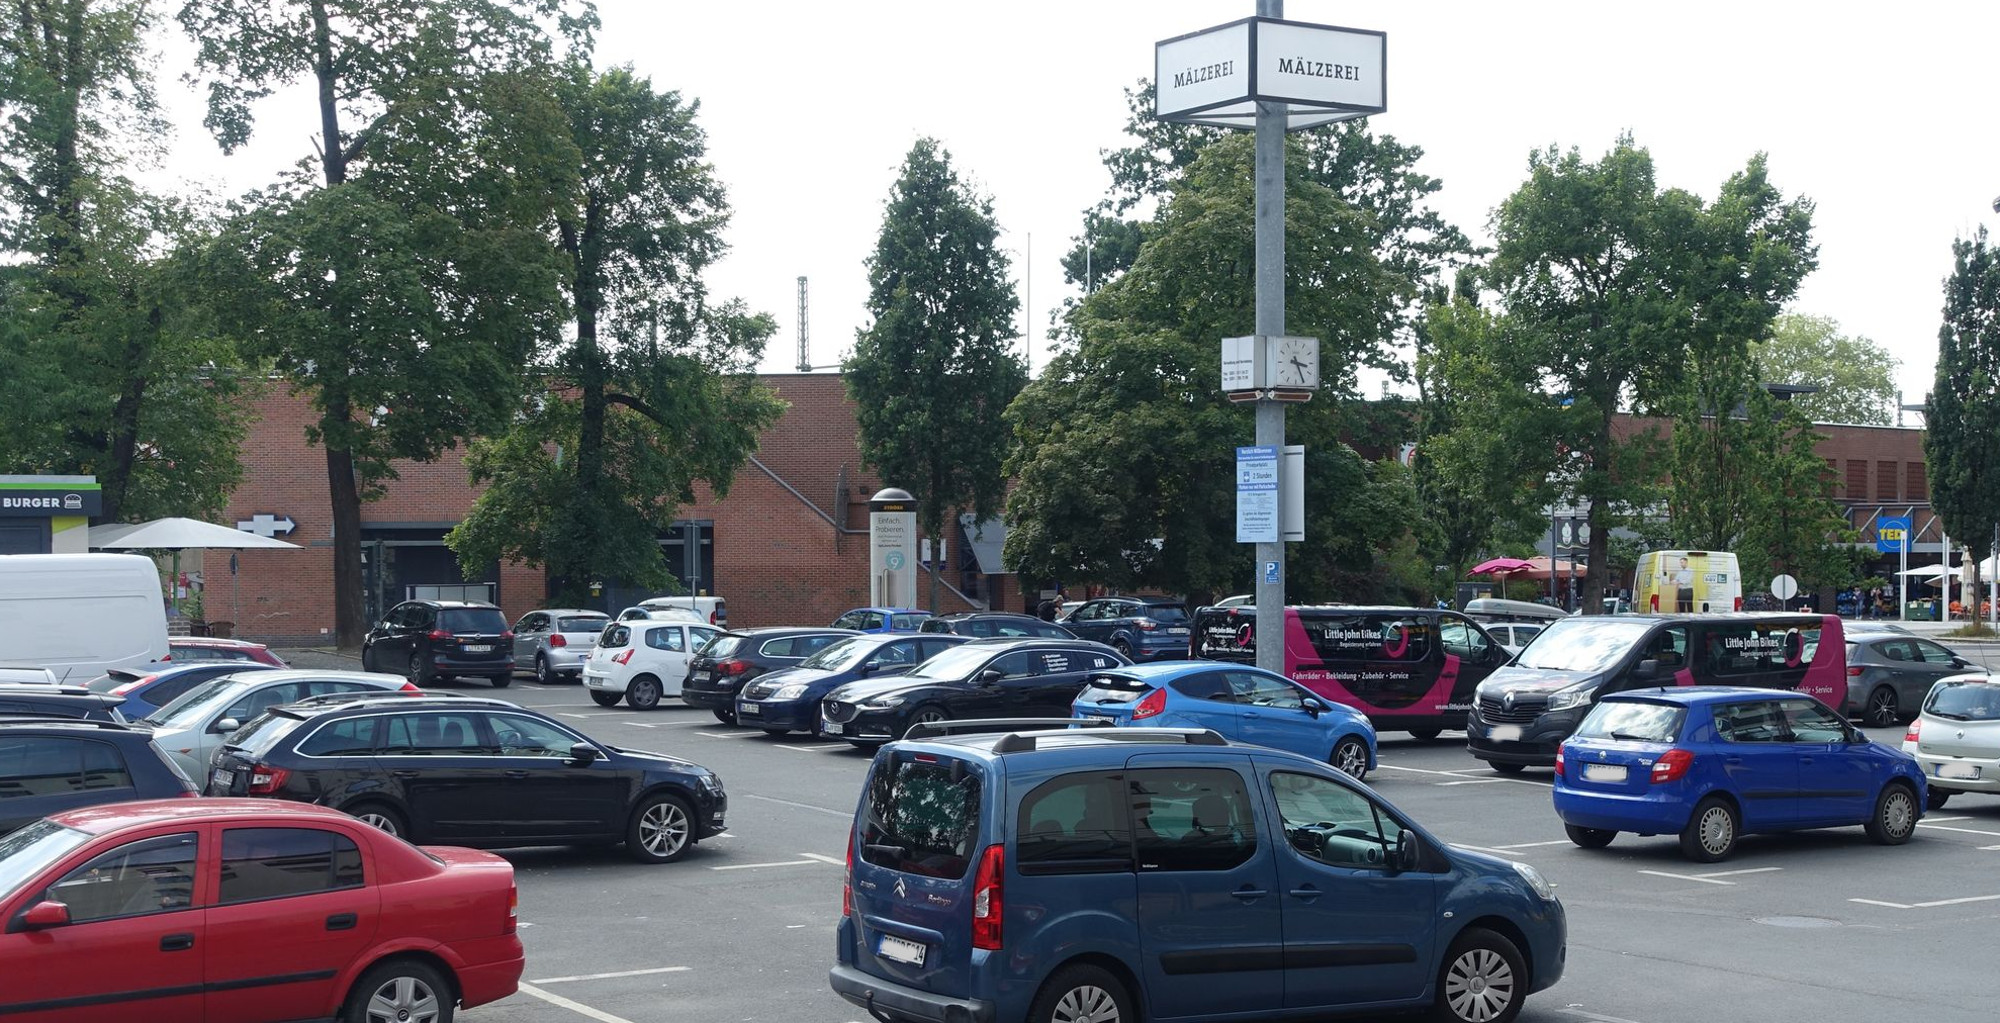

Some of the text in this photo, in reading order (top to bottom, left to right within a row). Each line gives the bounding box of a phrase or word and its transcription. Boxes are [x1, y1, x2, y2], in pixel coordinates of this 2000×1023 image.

[1173, 60, 1234, 88] MÄLZEREI
[1278, 57, 1360, 81] MÄLZEREI
[3, 497, 60, 508] BURGER
[878, 517, 901, 525] Einfach.
[1879, 529, 1908, 540] TED
[1266, 563, 1275, 574] P
[1325, 629, 1381, 640] Little John Bikes
[1339, 641, 1364, 649] Begeisterung
[1725, 637, 1779, 649] Little John Bikes
[1292, 672, 1409, 681] Fahrräder Bekleidung Zubehör Service
[1815, 686, 1833, 694] Service
[1435, 703, 1472, 712] www.littlejohnb
